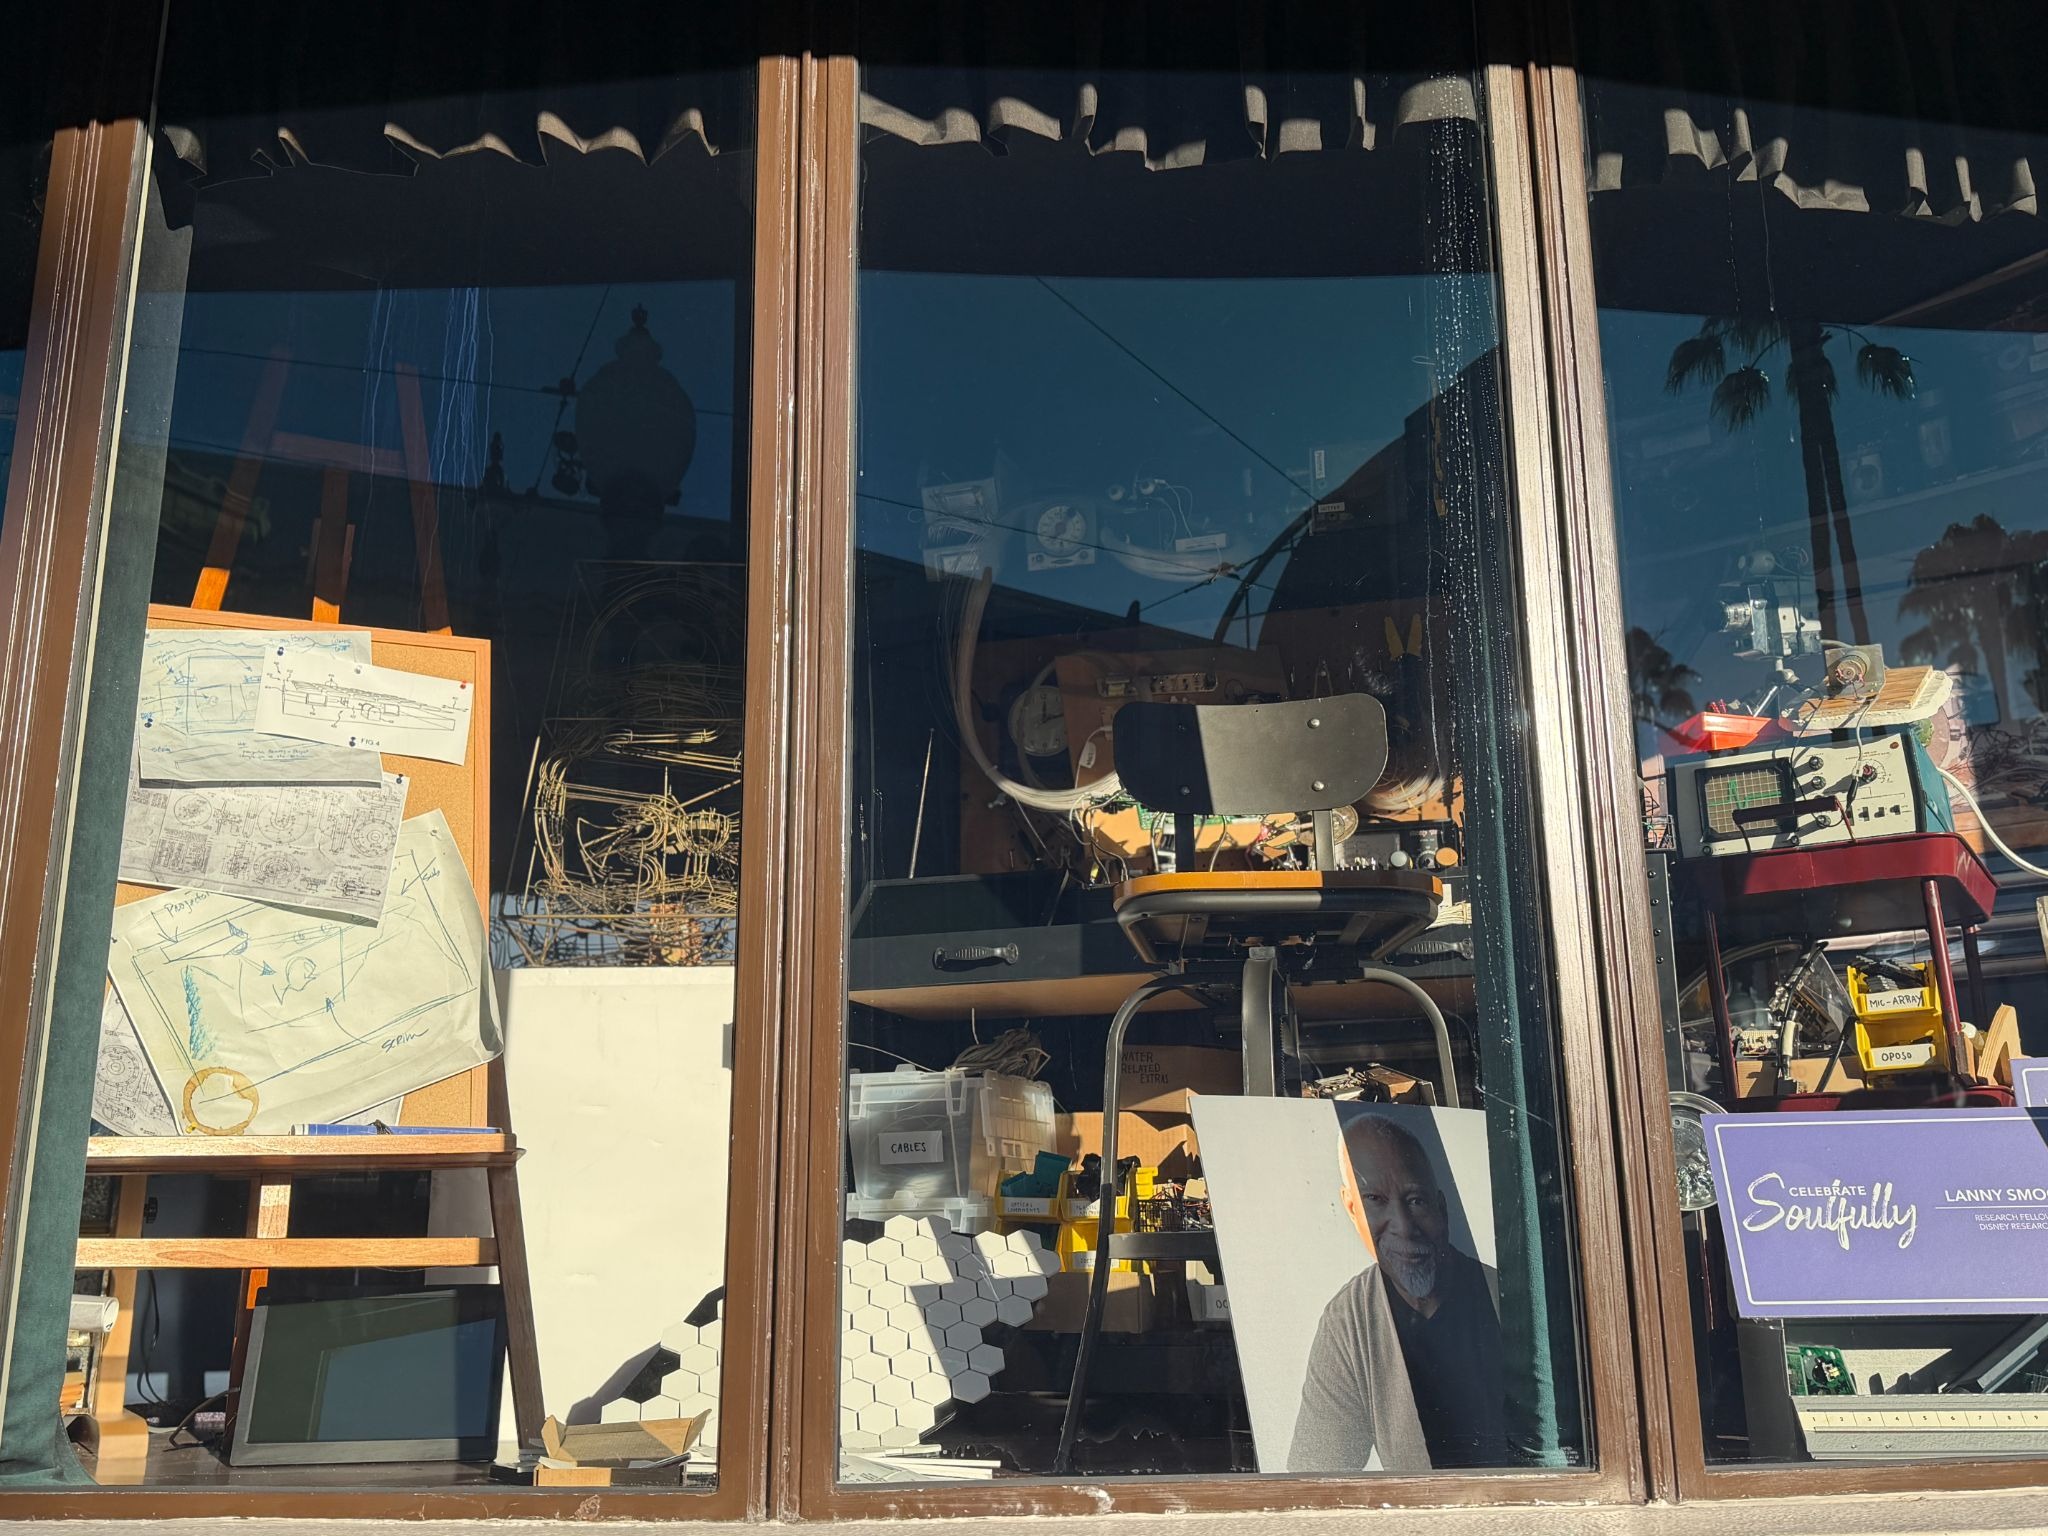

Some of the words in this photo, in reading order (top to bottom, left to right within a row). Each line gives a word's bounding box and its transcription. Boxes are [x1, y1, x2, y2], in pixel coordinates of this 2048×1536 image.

[1121, 1062, 1161, 1074] RELATED
[890, 1142, 927, 1154] CABLES
[1788, 1185, 1867, 1197] CELEBRATE
[1944, 1188, 2002, 1202] LANNY
[2006, 1188, 2048, 1201] SMO
[1742, 1172, 1918, 1251] Soulfully
[1975, 1213, 2018, 1222] RESEARCH
[1979, 1223, 2010, 1231] DISNEY
